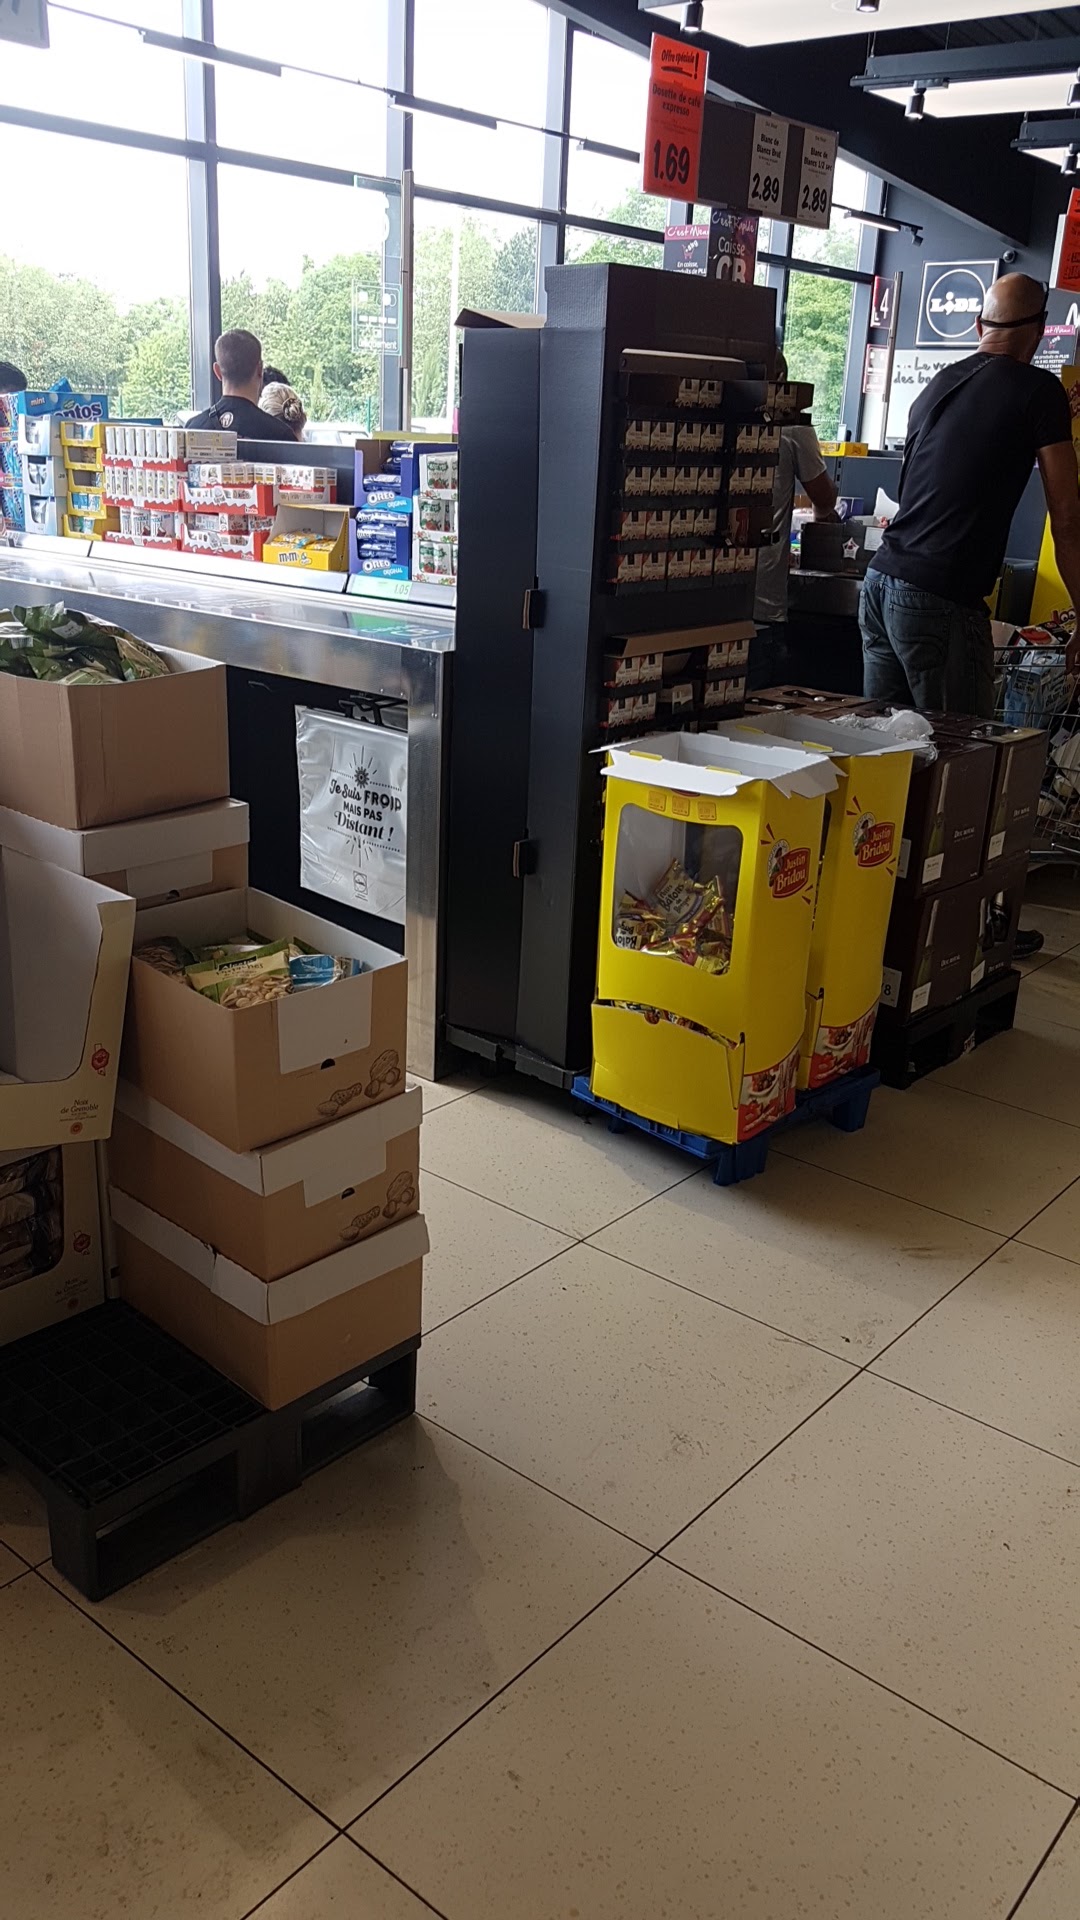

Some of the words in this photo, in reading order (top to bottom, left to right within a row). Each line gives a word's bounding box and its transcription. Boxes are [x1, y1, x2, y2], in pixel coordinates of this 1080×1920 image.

[662, 49, 676, 62] Offre
[653, 84, 677, 99] Dosette
[679, 91, 687, 103] de
[688, 96, 702, 108] café
[662, 102, 690, 117] expresso
[761, 133, 773, 145] Blanc
[774, 138, 779, 146] de
[757, 144, 772, 156] Blancs
[772, 148, 782, 159] Brut
[810, 147, 822, 158] Blanc
[654, 138, 690, 185] 1.69
[804, 157, 817, 168] Blancs
[825, 164, 833, 172] sec
[752, 173, 779, 203] 2.89
[802, 184, 827, 213] 2.89
[712, 211, 733, 229] C'est
[667, 226, 689, 237] C'est
[718, 236, 746, 257] Caisse
[880, 287, 889, 320] 4
[914, 356, 931, 371] Le
[894, 371, 914, 384] des
[30, 397, 46, 407] mint
[54, 402, 103, 421] entos
[368, 491, 395, 506] OREO
[363, 559, 391, 574] OREO
[394, 583, 409, 595] 1.05
[329, 779, 342, 794] Je
[342, 783, 362, 801] Suis
[343, 801, 362, 817] MAIS
[364, 808, 383, 822] PAS
[334, 810, 384, 840] Distant
[870, 828, 892, 845] Justin
[862, 840, 890, 861] Bridou
[784, 854, 806, 871] Justin
[776, 868, 806, 892] Bridou
[61, 1106, 69, 1114] de
[70, 1103, 99, 1113] Grenoble
